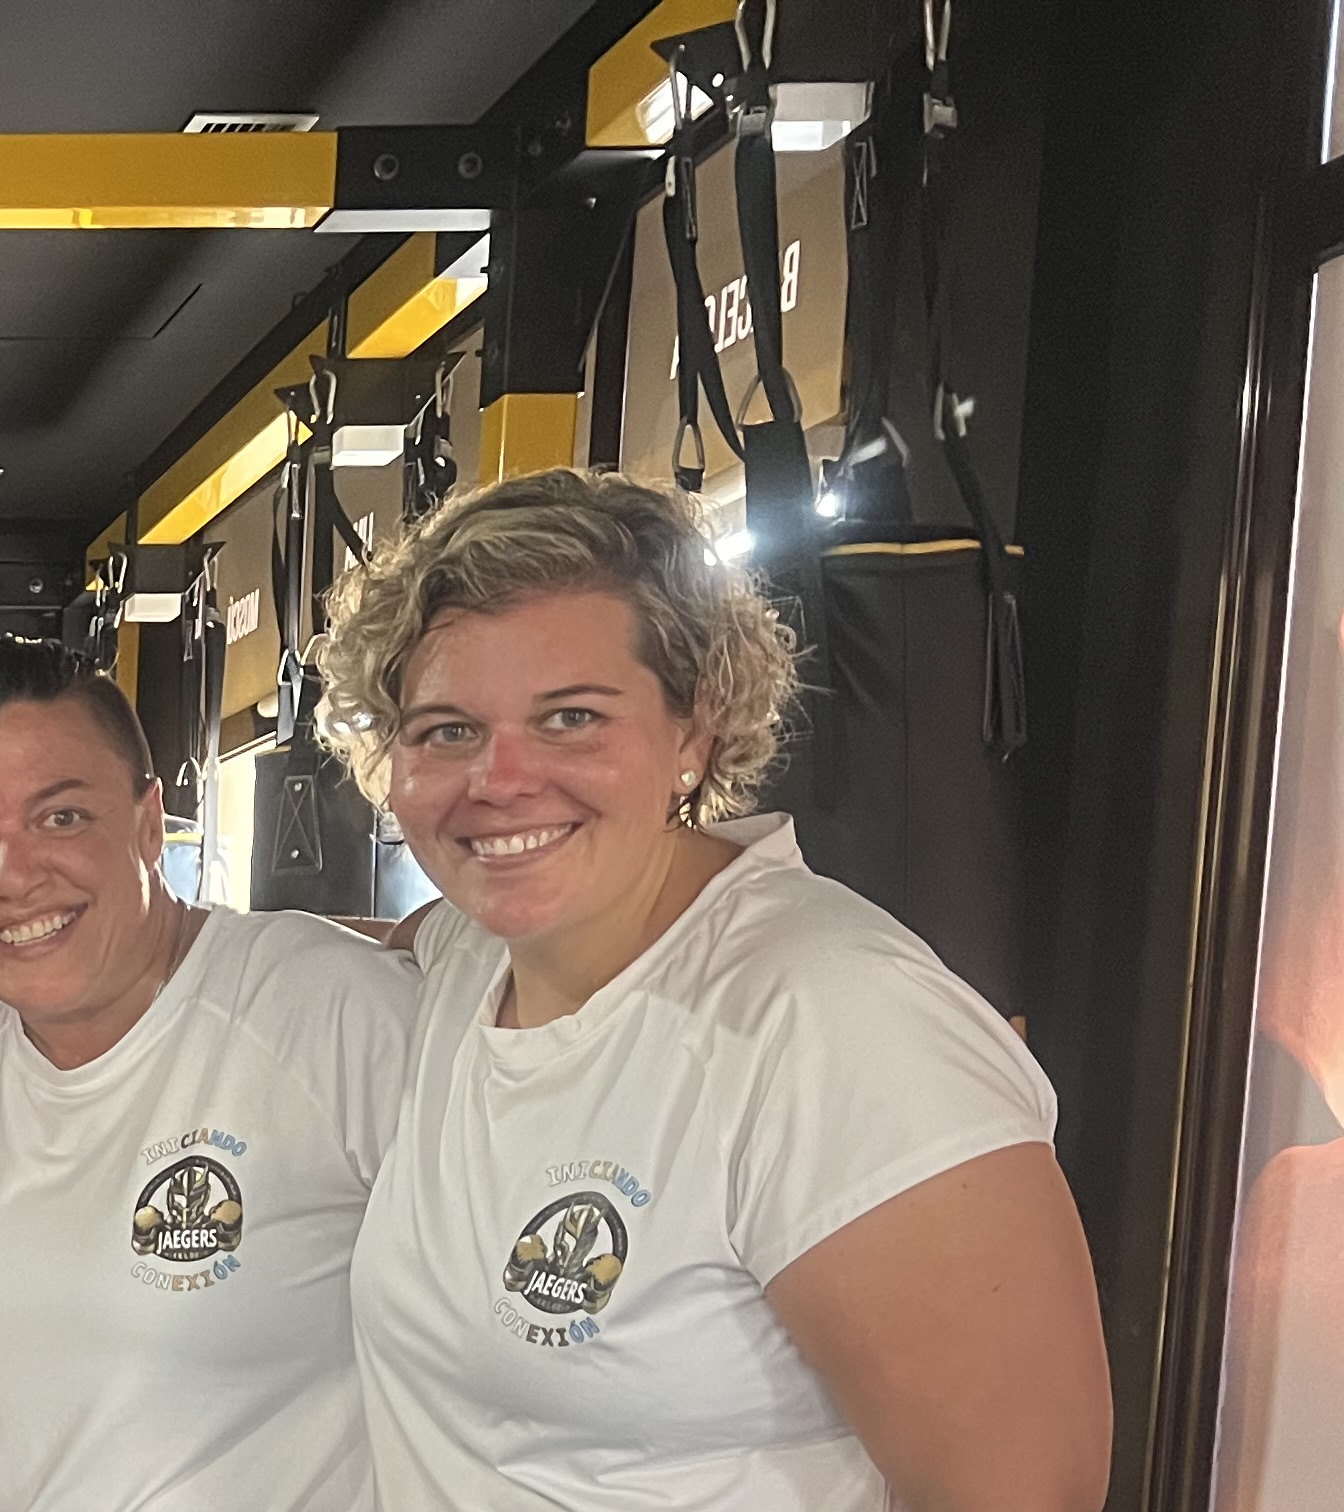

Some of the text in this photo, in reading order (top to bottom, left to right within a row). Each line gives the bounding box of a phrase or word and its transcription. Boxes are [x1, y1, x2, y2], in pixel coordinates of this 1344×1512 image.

[140, 1127, 248, 1165] INICIANDO
[545, 1160, 652, 1208] INICIANDO
[156, 1228, 218, 1255] JAEGERS
[524, 1270, 588, 1304] JAEGERS
